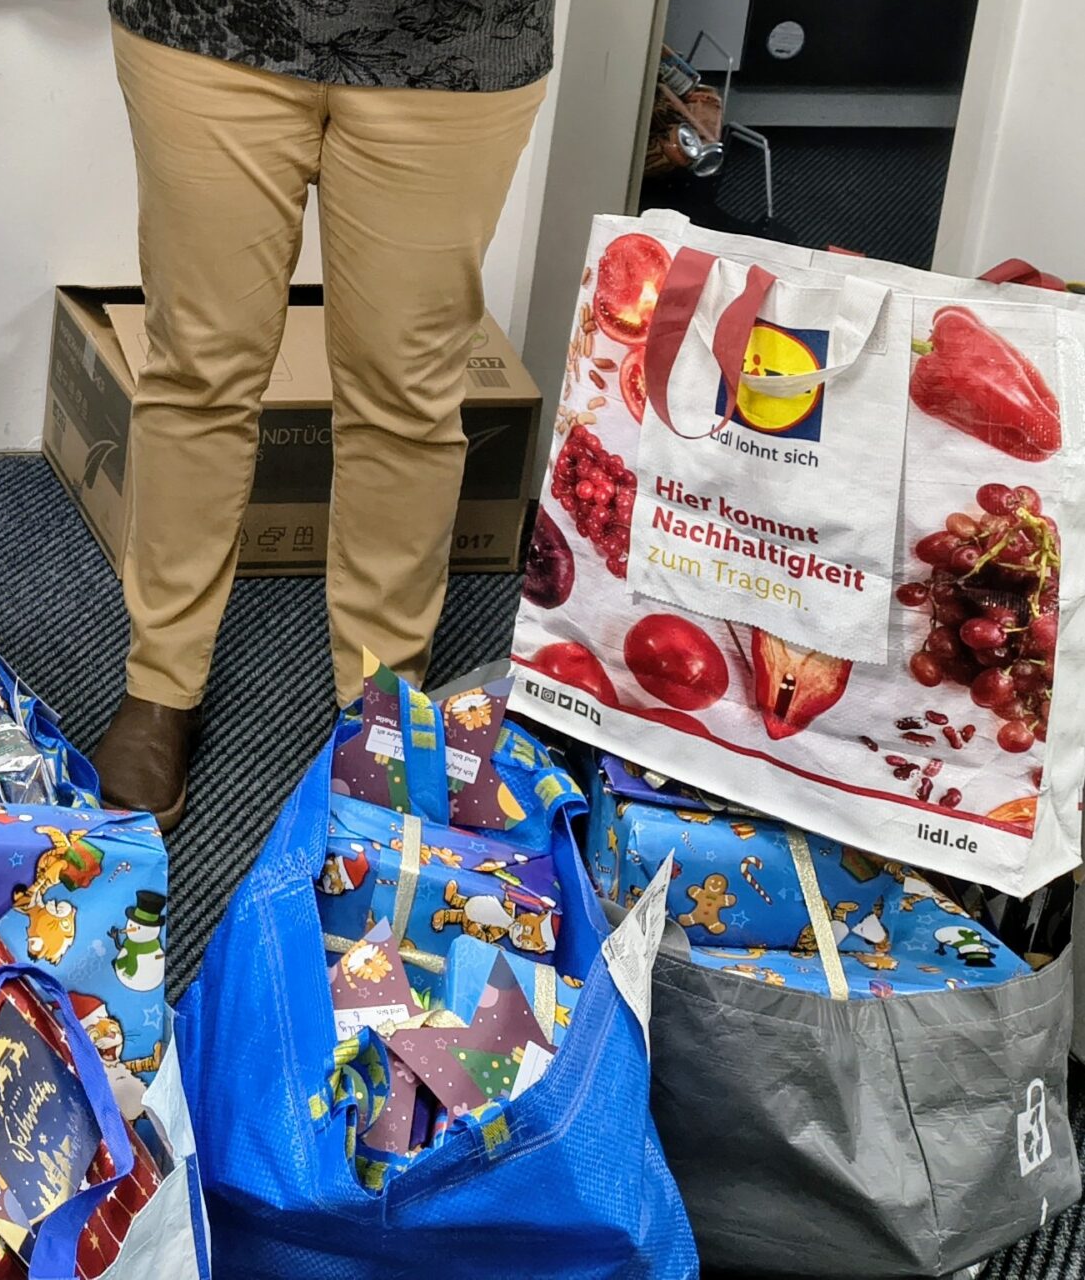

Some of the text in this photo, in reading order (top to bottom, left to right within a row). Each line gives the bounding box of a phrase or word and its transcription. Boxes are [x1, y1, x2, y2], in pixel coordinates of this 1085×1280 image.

[469, 358, 501, 368] 017
[261, 424, 331, 445] NDTÜC
[710, 423, 819, 468] Lidl lohnt sich
[655, 475, 820, 545] Hier kommt
[456, 533, 495, 549] 017
[652, 506, 865, 592] Nachhaltigkeit
[648, 545, 809, 612] zum Tragen.
[452, 752, 463, 760] bin
[917, 823, 978, 854] lidl.de
[4, 1081, 57, 1163] Weihnachten
